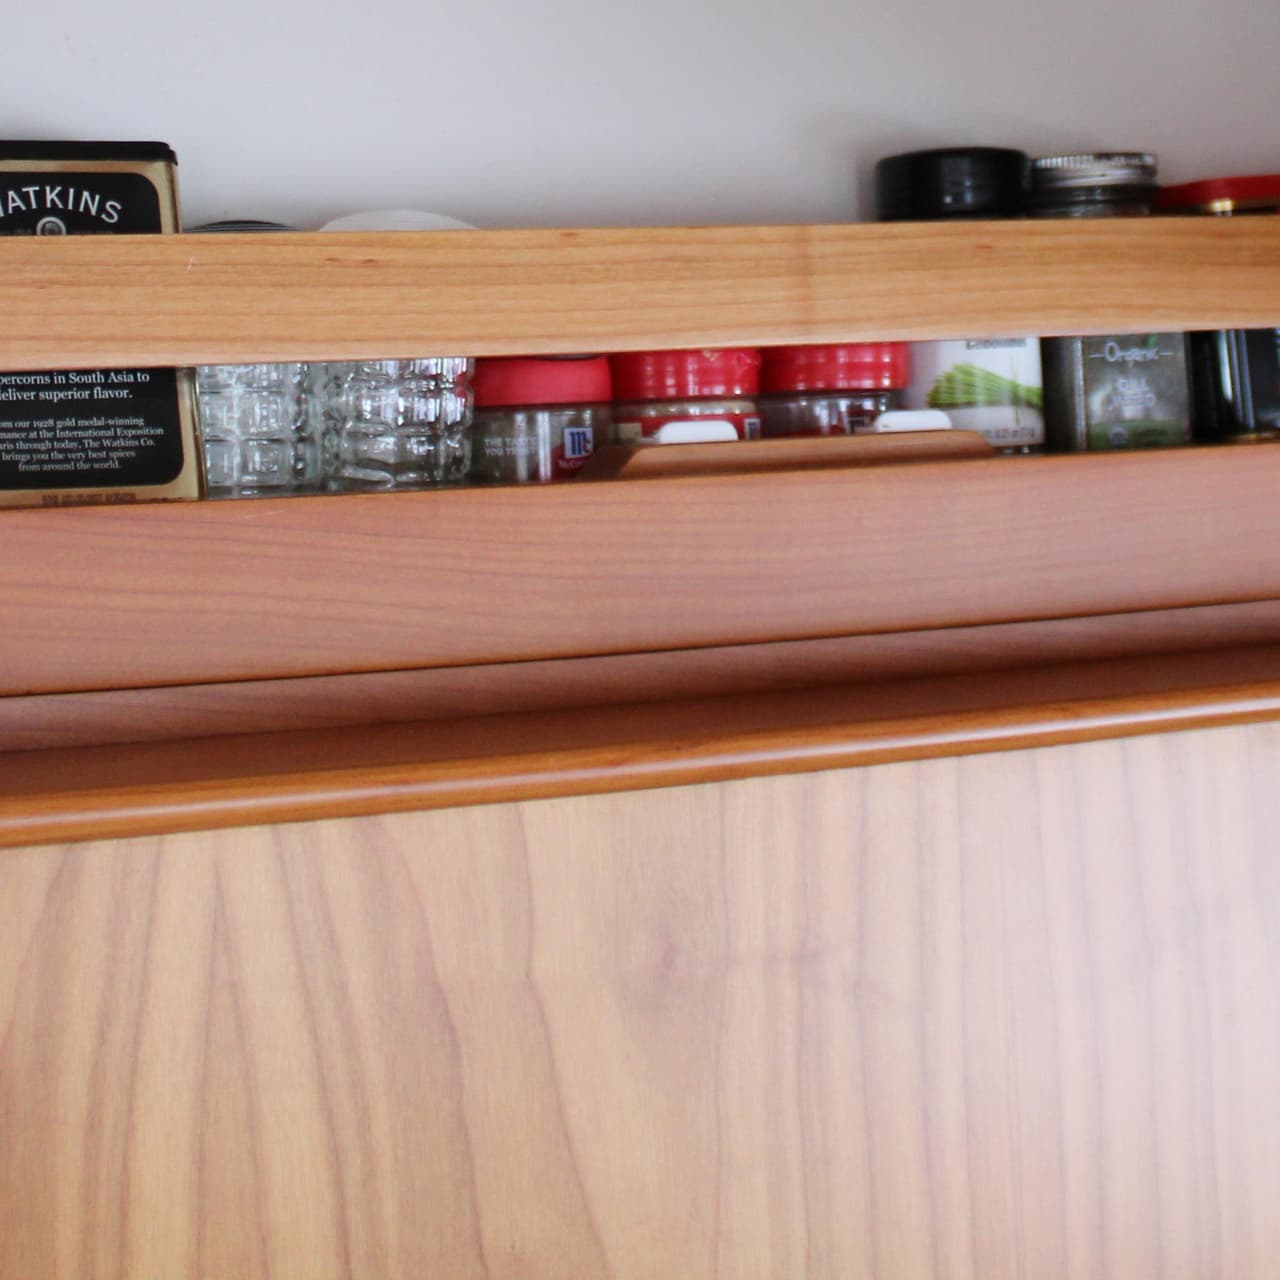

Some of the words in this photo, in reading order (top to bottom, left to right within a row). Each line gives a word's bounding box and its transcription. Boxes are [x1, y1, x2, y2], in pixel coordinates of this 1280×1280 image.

[53, 372, 67, 385] in
[68, 371, 104, 384] South
[107, 370, 135, 384] Asia
[136, 370, 150, 383] to
[38, 389, 91, 403] superior
[93, 386, 133, 400] flavor.
[14, 420, 31, 429] our
[32, 419, 54, 429] 1928
[55, 418, 76, 431] gold
[77, 416, 145, 428] medal-winning
[28, 429, 39, 439] at
[39, 428, 54, 439] the
[55, 427, 115, 438] International
[116, 425, 165, 437] Exposition
[15, 440, 52, 452] through
[53, 439, 82, 451] today.
[82, 439, 101, 449] The
[102, 438, 140, 449] Watkins
[140, 437, 157, 447] Co.
[1, 451, 31, 464] brings
[32, 452, 49, 463] you
[50, 451, 65, 461] the
[88, 449, 107, 460] best
[18, 462, 41, 472] from
[42, 461, 75, 472] around
[76, 460, 91, 471] the
